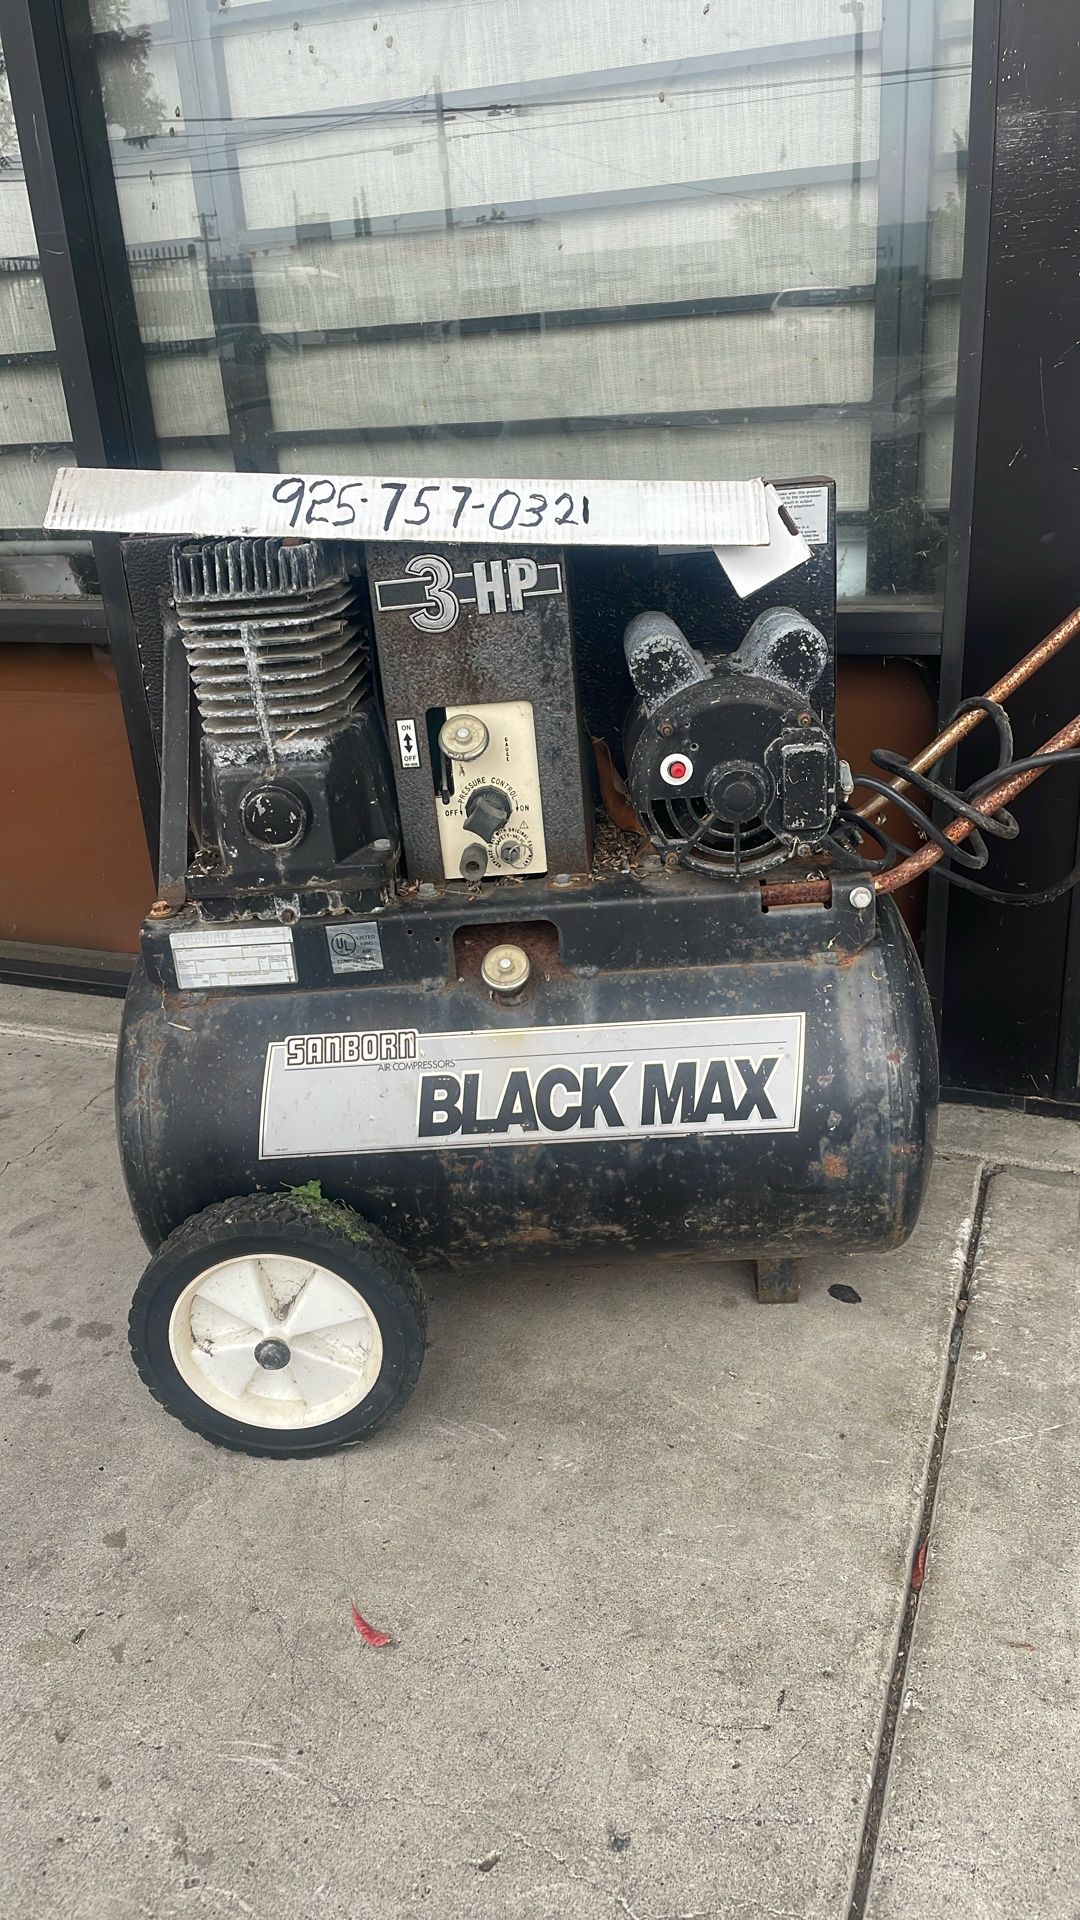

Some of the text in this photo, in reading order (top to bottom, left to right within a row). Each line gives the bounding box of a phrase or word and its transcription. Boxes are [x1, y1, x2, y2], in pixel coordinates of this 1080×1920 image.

[404, 553, 539, 633] 3 HP
[457, 776, 518, 804] PRESSURE CONTROL
[444, 809, 459, 817] OFF
[286, 1031, 417, 1066] SANBORN
[377, 1059, 456, 1072] AIR COMPRESSORS
[417, 1056, 780, 1138] BLACK MAX
